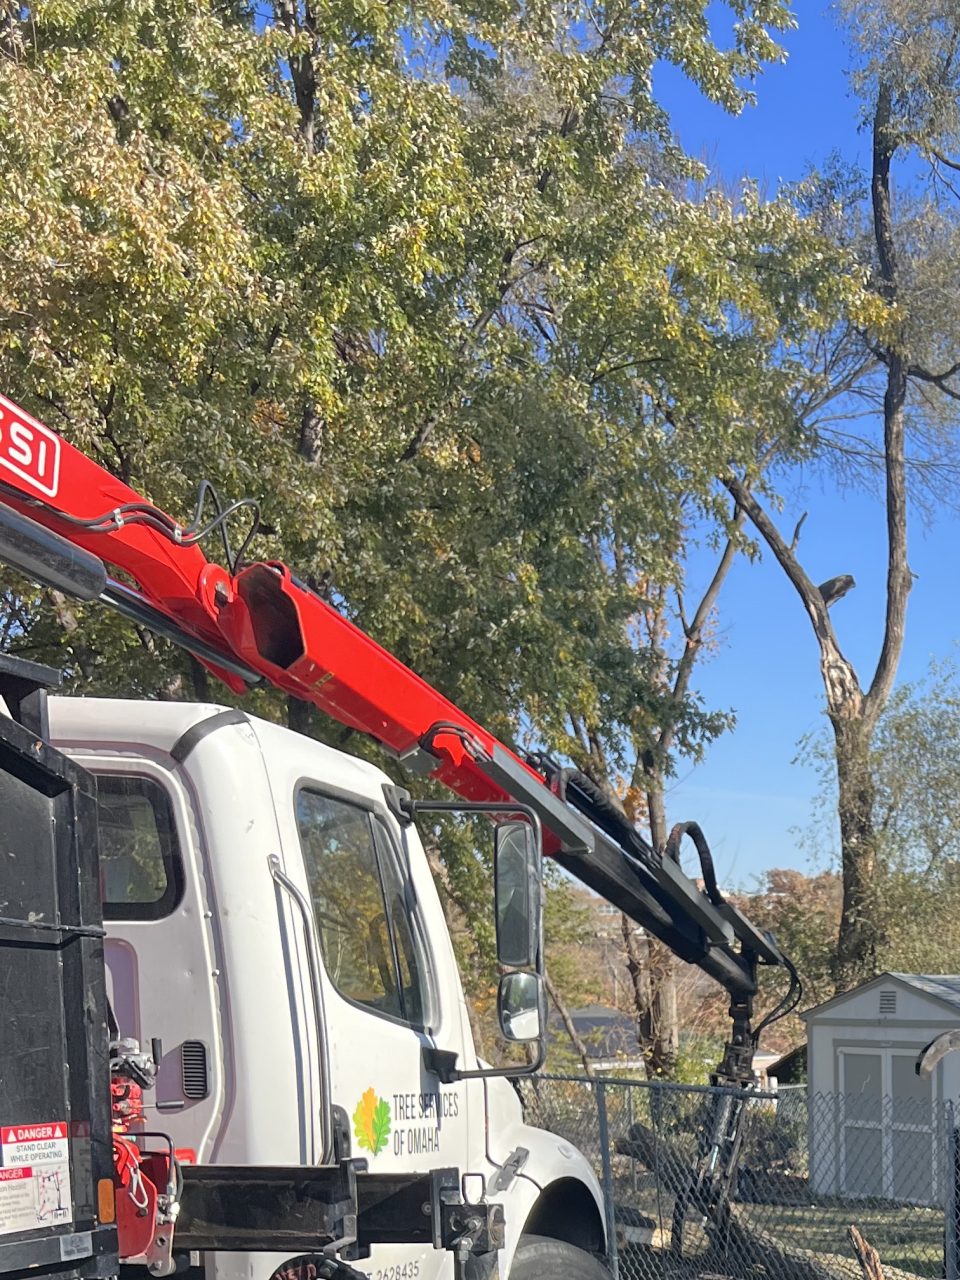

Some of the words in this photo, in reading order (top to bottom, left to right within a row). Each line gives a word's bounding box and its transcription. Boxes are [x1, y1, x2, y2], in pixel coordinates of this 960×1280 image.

[393, 1094, 416, 1120] TREE
[17, 1126, 53, 1141] DANGER
[16, 1143, 36, 1153] STAND
[36, 1141, 56, 1151] CLEAR
[393, 1129, 405, 1156] OF
[407, 1126, 440, 1155] OMAHA
[10, 1154, 29, 1163] WHILE
[30, 1150, 63, 1161] OPERATING
[0, 1168, 24, 1180] ANGER
